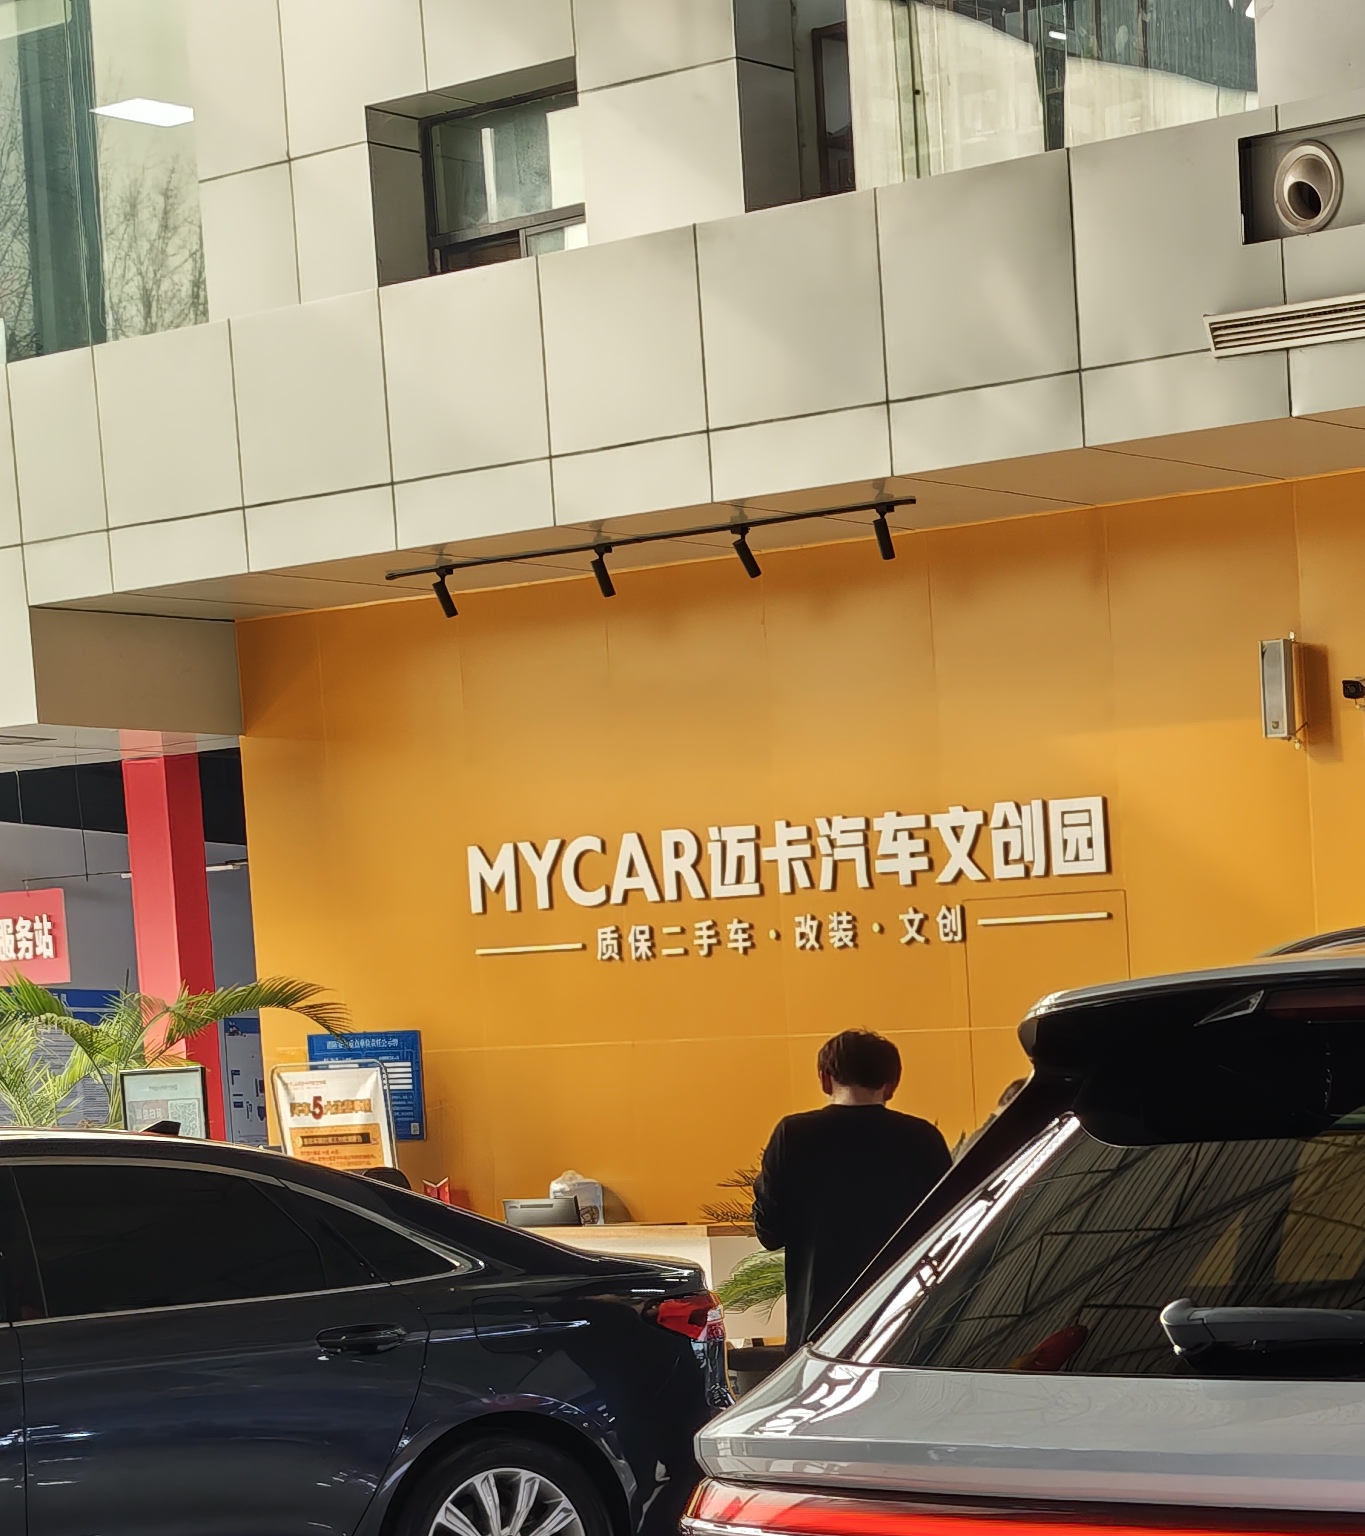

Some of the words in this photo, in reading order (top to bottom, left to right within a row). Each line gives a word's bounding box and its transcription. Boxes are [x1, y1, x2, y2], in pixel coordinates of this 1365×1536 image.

[466, 797, 1109, 914] MYCAR迈卡汽车文创园
